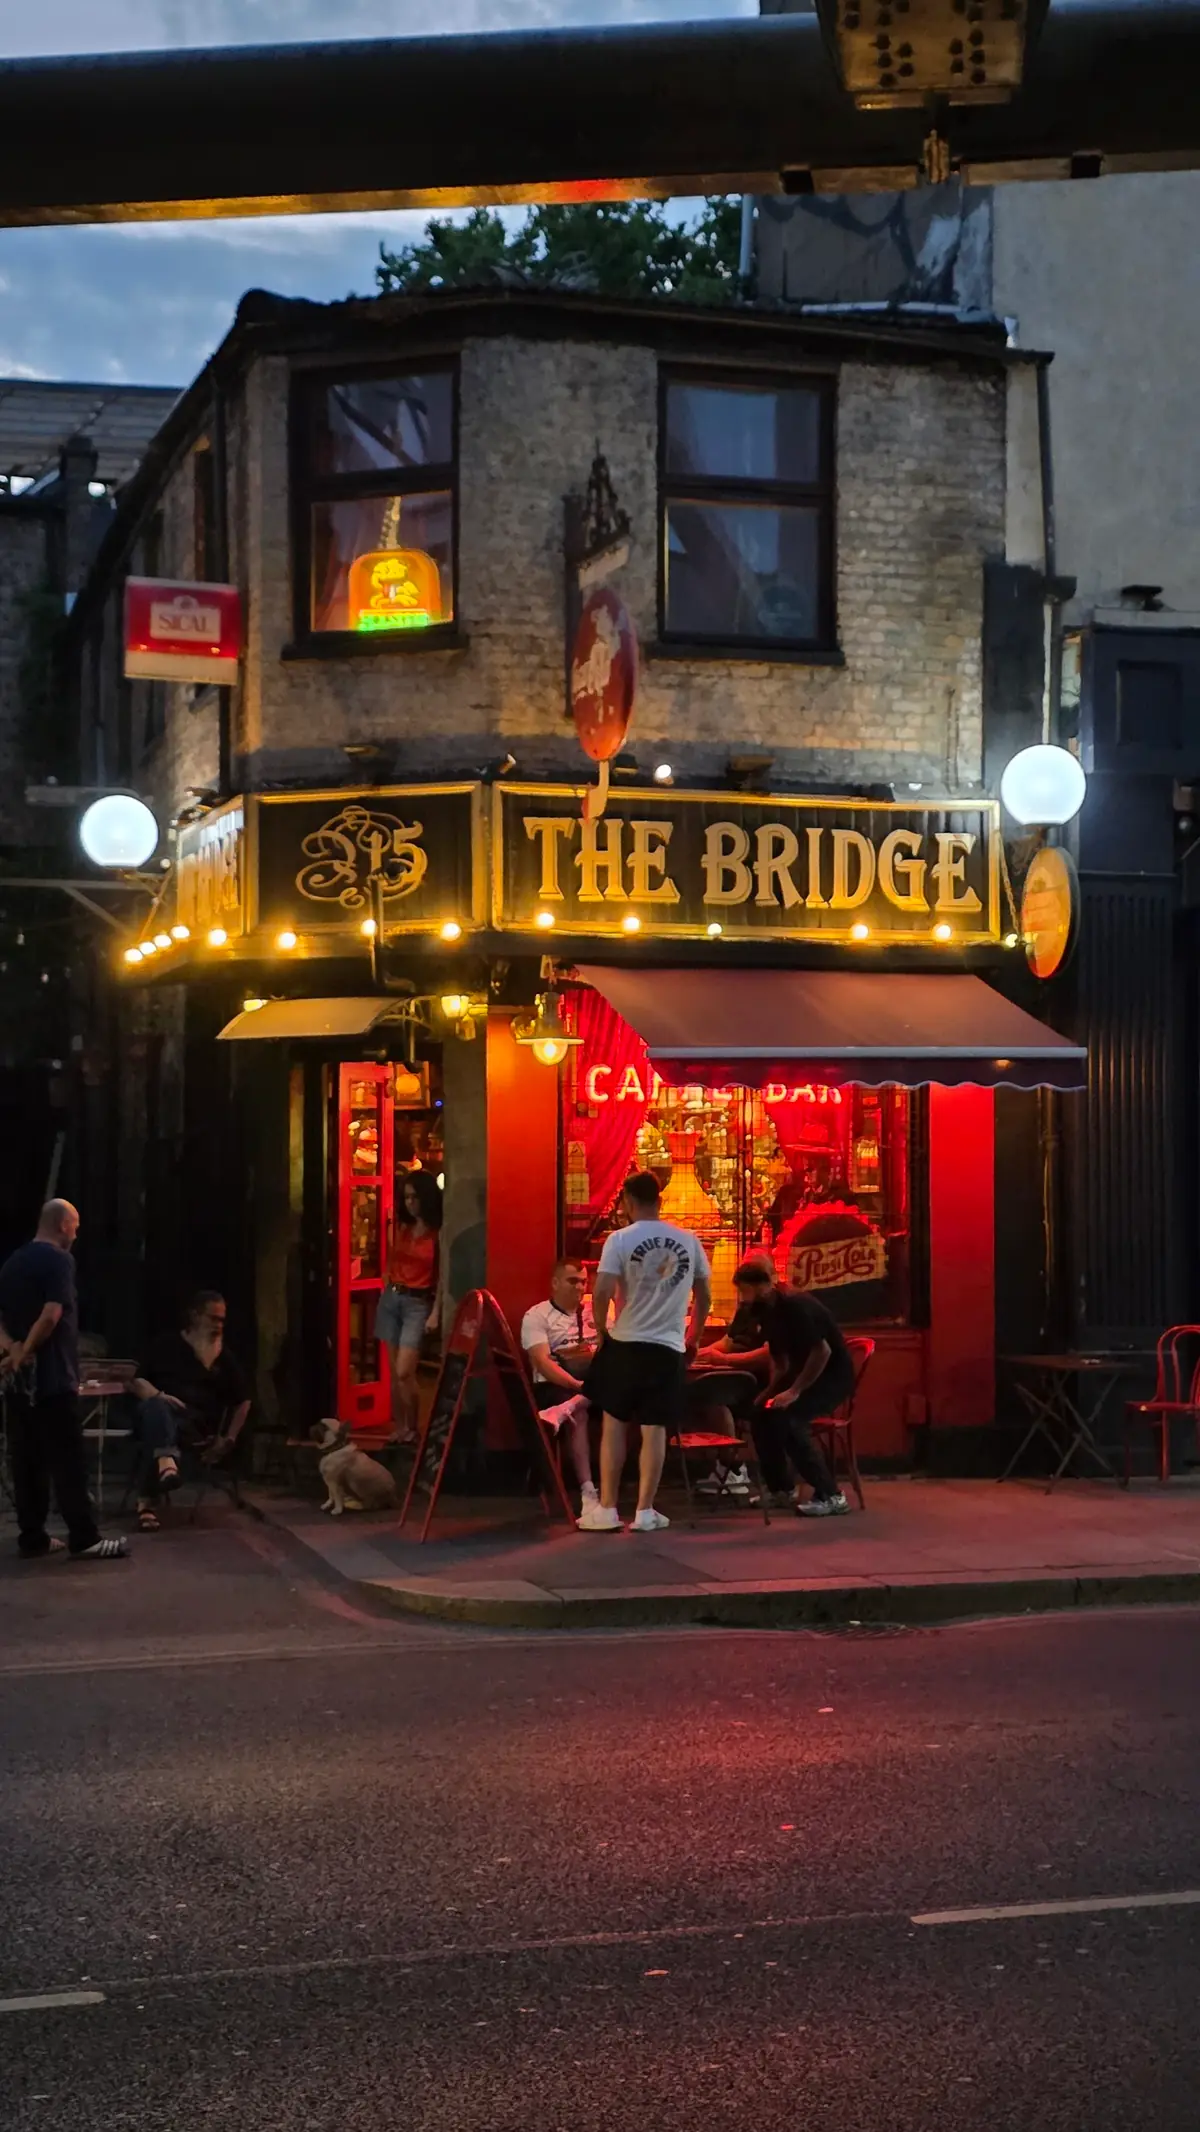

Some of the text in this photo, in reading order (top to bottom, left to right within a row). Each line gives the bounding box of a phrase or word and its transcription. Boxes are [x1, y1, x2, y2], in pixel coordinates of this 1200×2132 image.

[523, 816, 983, 914] THE BRIDGE
[630, 1236, 663, 1263] TRUE
